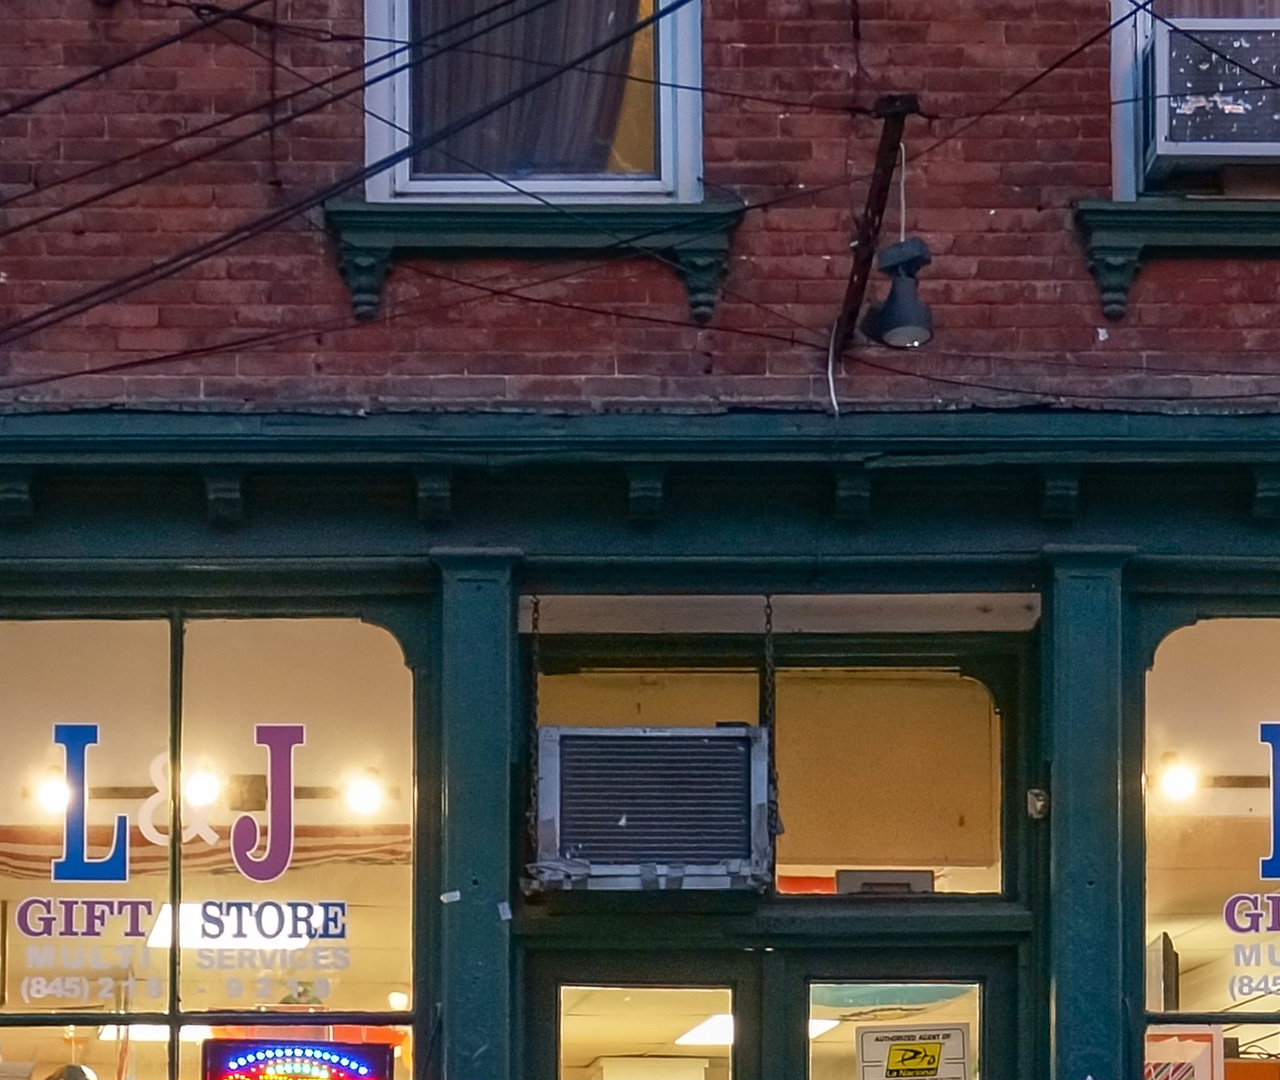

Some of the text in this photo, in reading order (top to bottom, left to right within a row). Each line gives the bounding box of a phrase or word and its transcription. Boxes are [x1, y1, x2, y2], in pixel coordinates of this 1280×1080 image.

[16, 896, 348, 940] GIFT STORE
[26, 946, 351, 970] MULTI SERVICES
